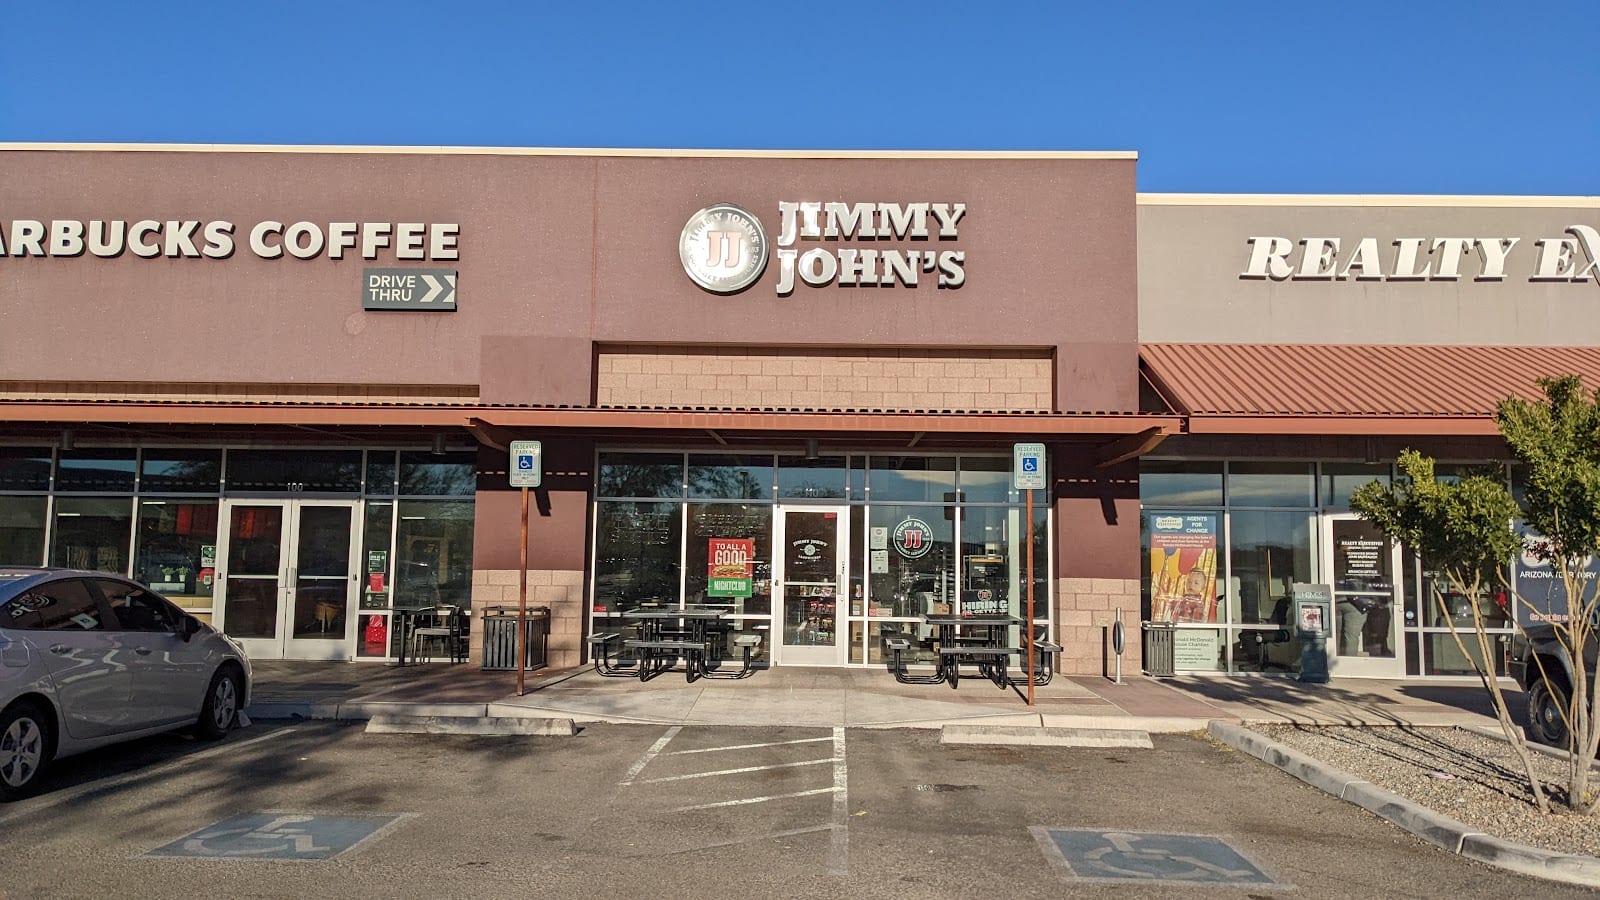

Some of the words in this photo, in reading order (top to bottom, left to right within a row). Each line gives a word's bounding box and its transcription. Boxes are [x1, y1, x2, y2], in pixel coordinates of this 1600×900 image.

[727, 213, 760, 243] JOHN'S
[779, 202, 966, 245] JIMMY
[0, 219, 236, 258] RBUCKS
[249, 221, 460, 260] COFFEE
[706, 230, 742, 268] JJ
[1239, 236, 1521, 282] REALTY
[777, 248, 966, 296] JOHN'S
[369, 275, 416, 288] DRIVE
[369, 289, 413, 301] THRU
[287, 482, 303, 493] 100
[904, 529, 923, 549] JJ
[714, 550, 747, 566] GOOD
[1519, 571, 1553, 579] ARIZONA
[713, 581, 747, 591] NIGHTCLUB
[962, 600, 1008, 611] HIRING
